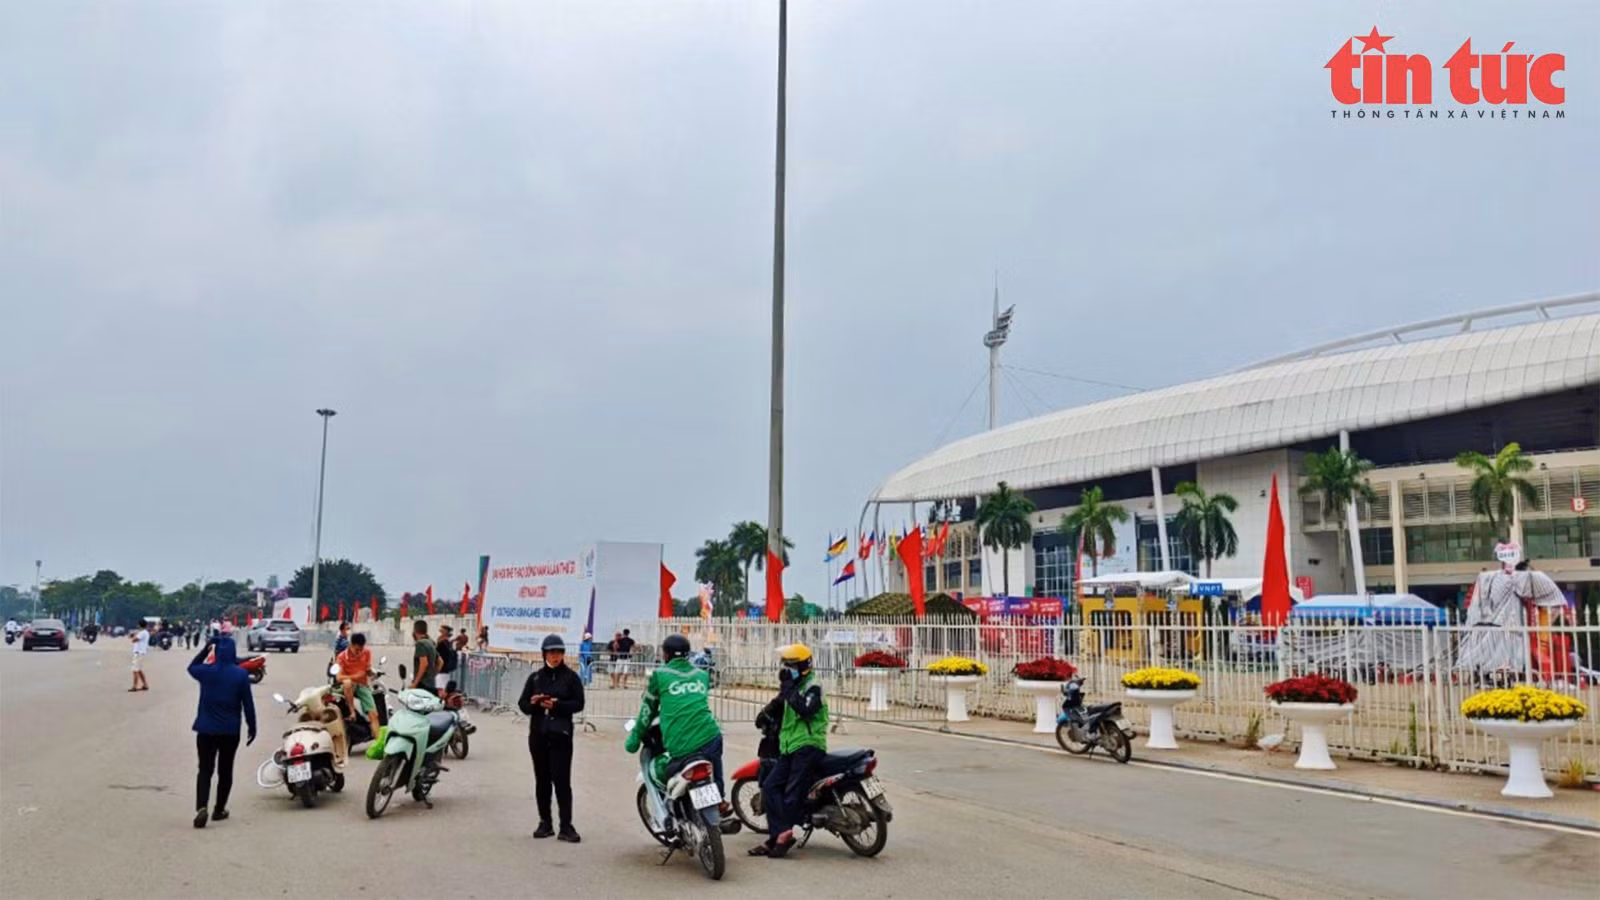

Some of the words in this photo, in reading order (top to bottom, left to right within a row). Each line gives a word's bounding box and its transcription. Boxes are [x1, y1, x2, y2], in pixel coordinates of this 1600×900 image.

[1573, 497, 1585, 512] B
[1199, 583, 1222, 592] VNPT
[668, 680, 706, 695] Grab
